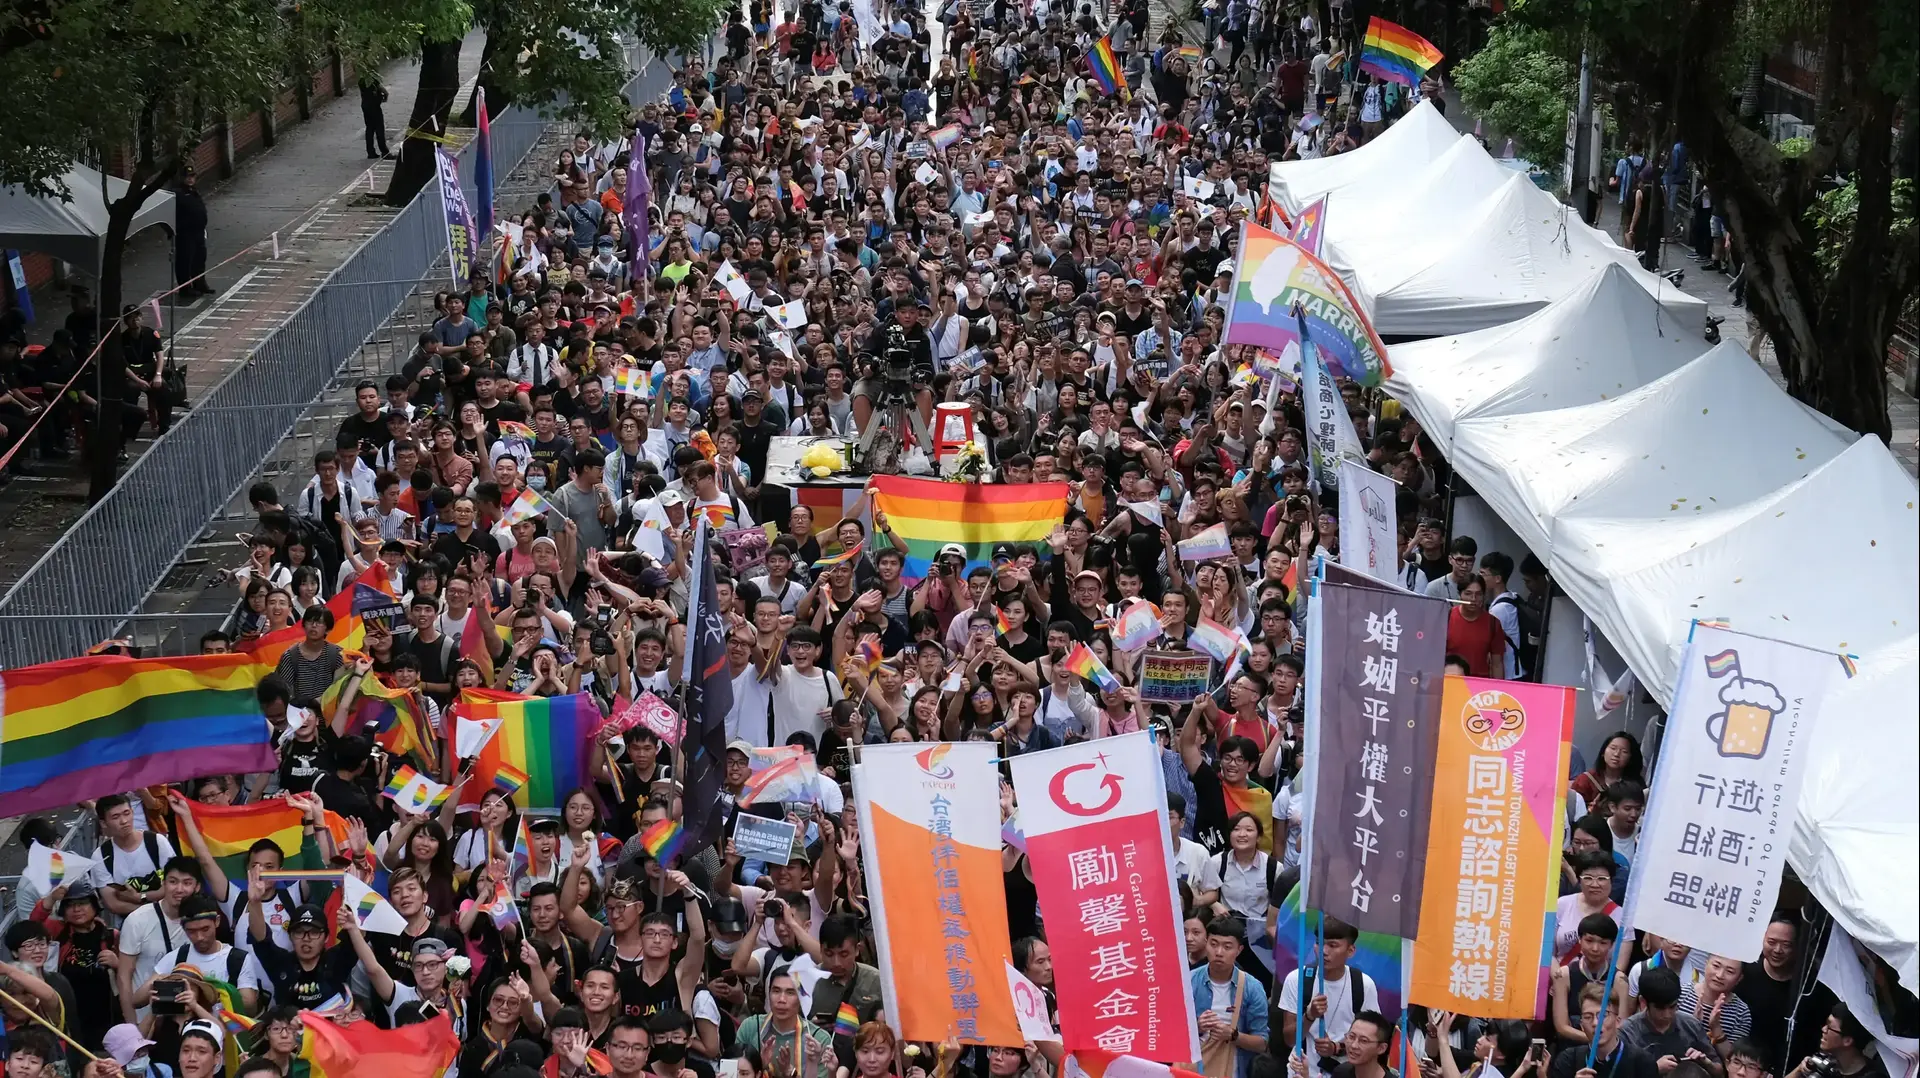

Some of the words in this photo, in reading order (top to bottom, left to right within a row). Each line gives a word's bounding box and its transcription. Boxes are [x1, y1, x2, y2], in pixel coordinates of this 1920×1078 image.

[445, 182, 461, 200] the
[1285, 289, 1362, 343] MARRY
[1360, 343, 1379, 372] ME
[1146, 660, 1208, 672] 我是女同志
[1351, 608, 1402, 913] 婚姻平權大平台
[1513, 749, 1525, 794] TAIWAN
[1508, 795, 1522, 847] TONGZHI
[1121, 840, 1135, 868] The
[1448, 755, 1507, 1001] 同志諮詢熱線
[1506, 848, 1518, 878] LGBT
[929, 792, 986, 1043] 台灣伴侶權益推動聯盟
[1128, 873, 1147, 923] Garden
[1500, 879, 1515, 928] HOTLINE
[1067, 844, 1140, 1053] 勵馨基金會
[1140, 927, 1153, 942] of
[1143, 942, 1156, 982] Hope
[1493, 928, 1510, 1002] ASSOCIATION
[1148, 984, 1160, 1051] Foundation
